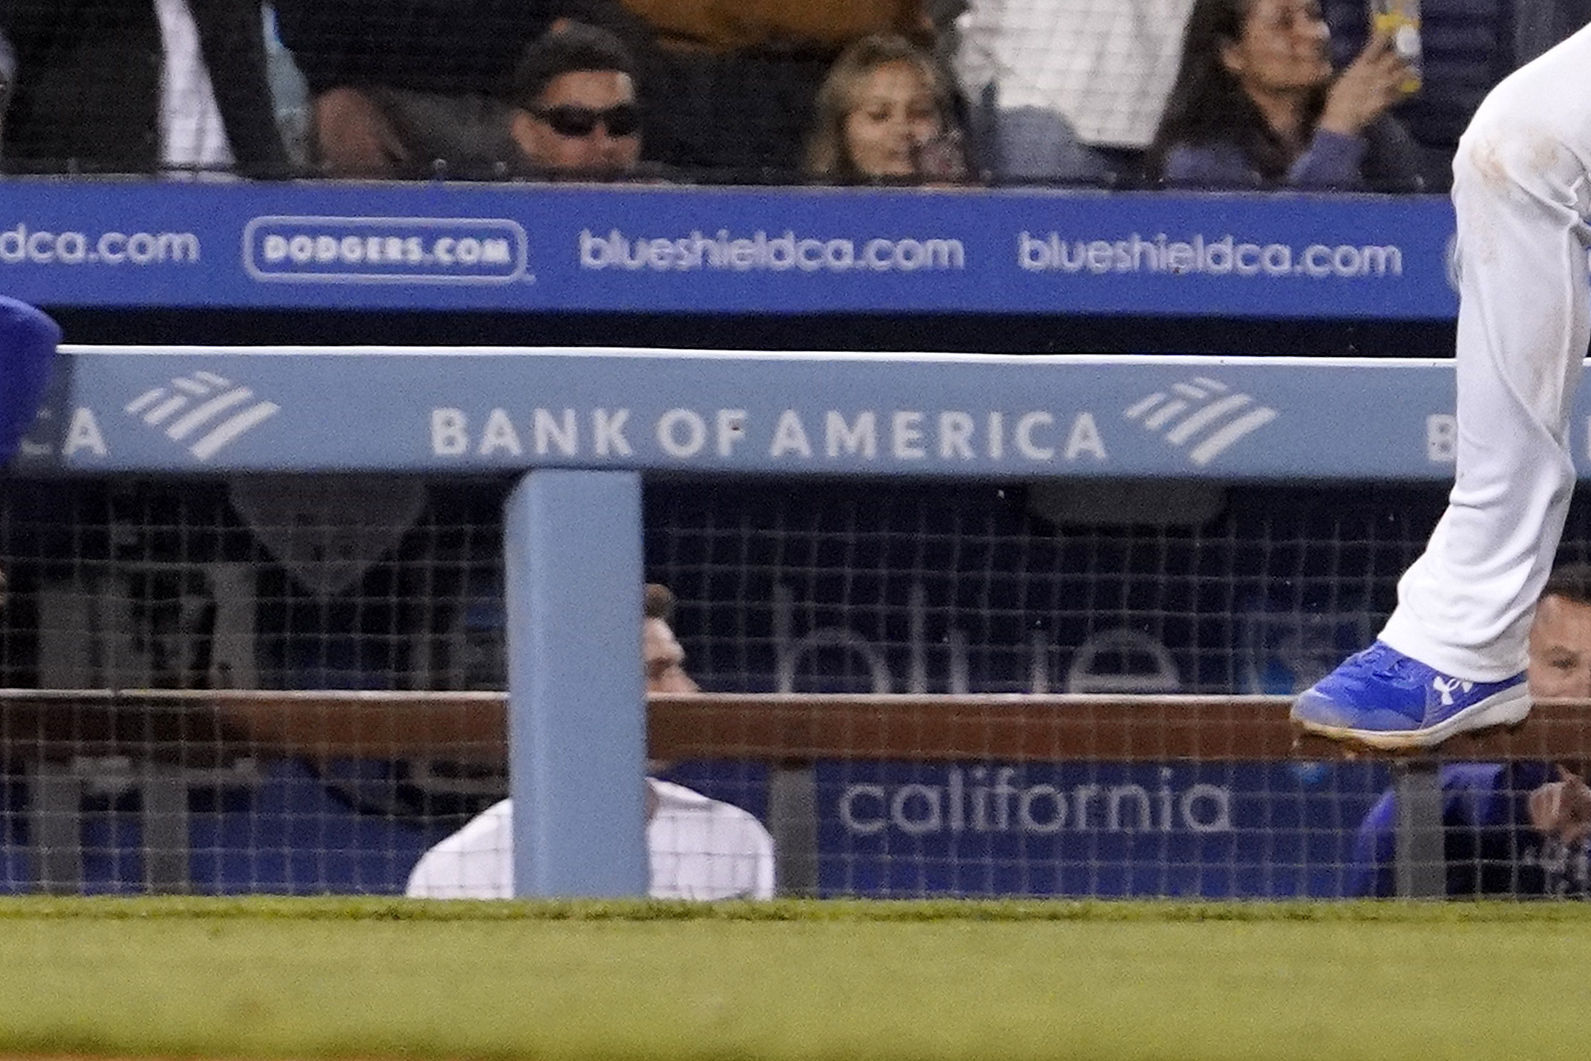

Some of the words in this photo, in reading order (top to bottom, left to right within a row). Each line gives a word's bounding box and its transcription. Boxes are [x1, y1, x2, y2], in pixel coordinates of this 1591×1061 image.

[263, 234, 512, 266] DODGERS.COM
[579, 228, 964, 273] blueshieldca.com
[1018, 231, 1403, 279] blueshieldca.com
[432, 409, 632, 456] BANK
[656, 410, 754, 458] OF
[771, 411, 1107, 462] AMERICA
[839, 767, 1232, 836] california
